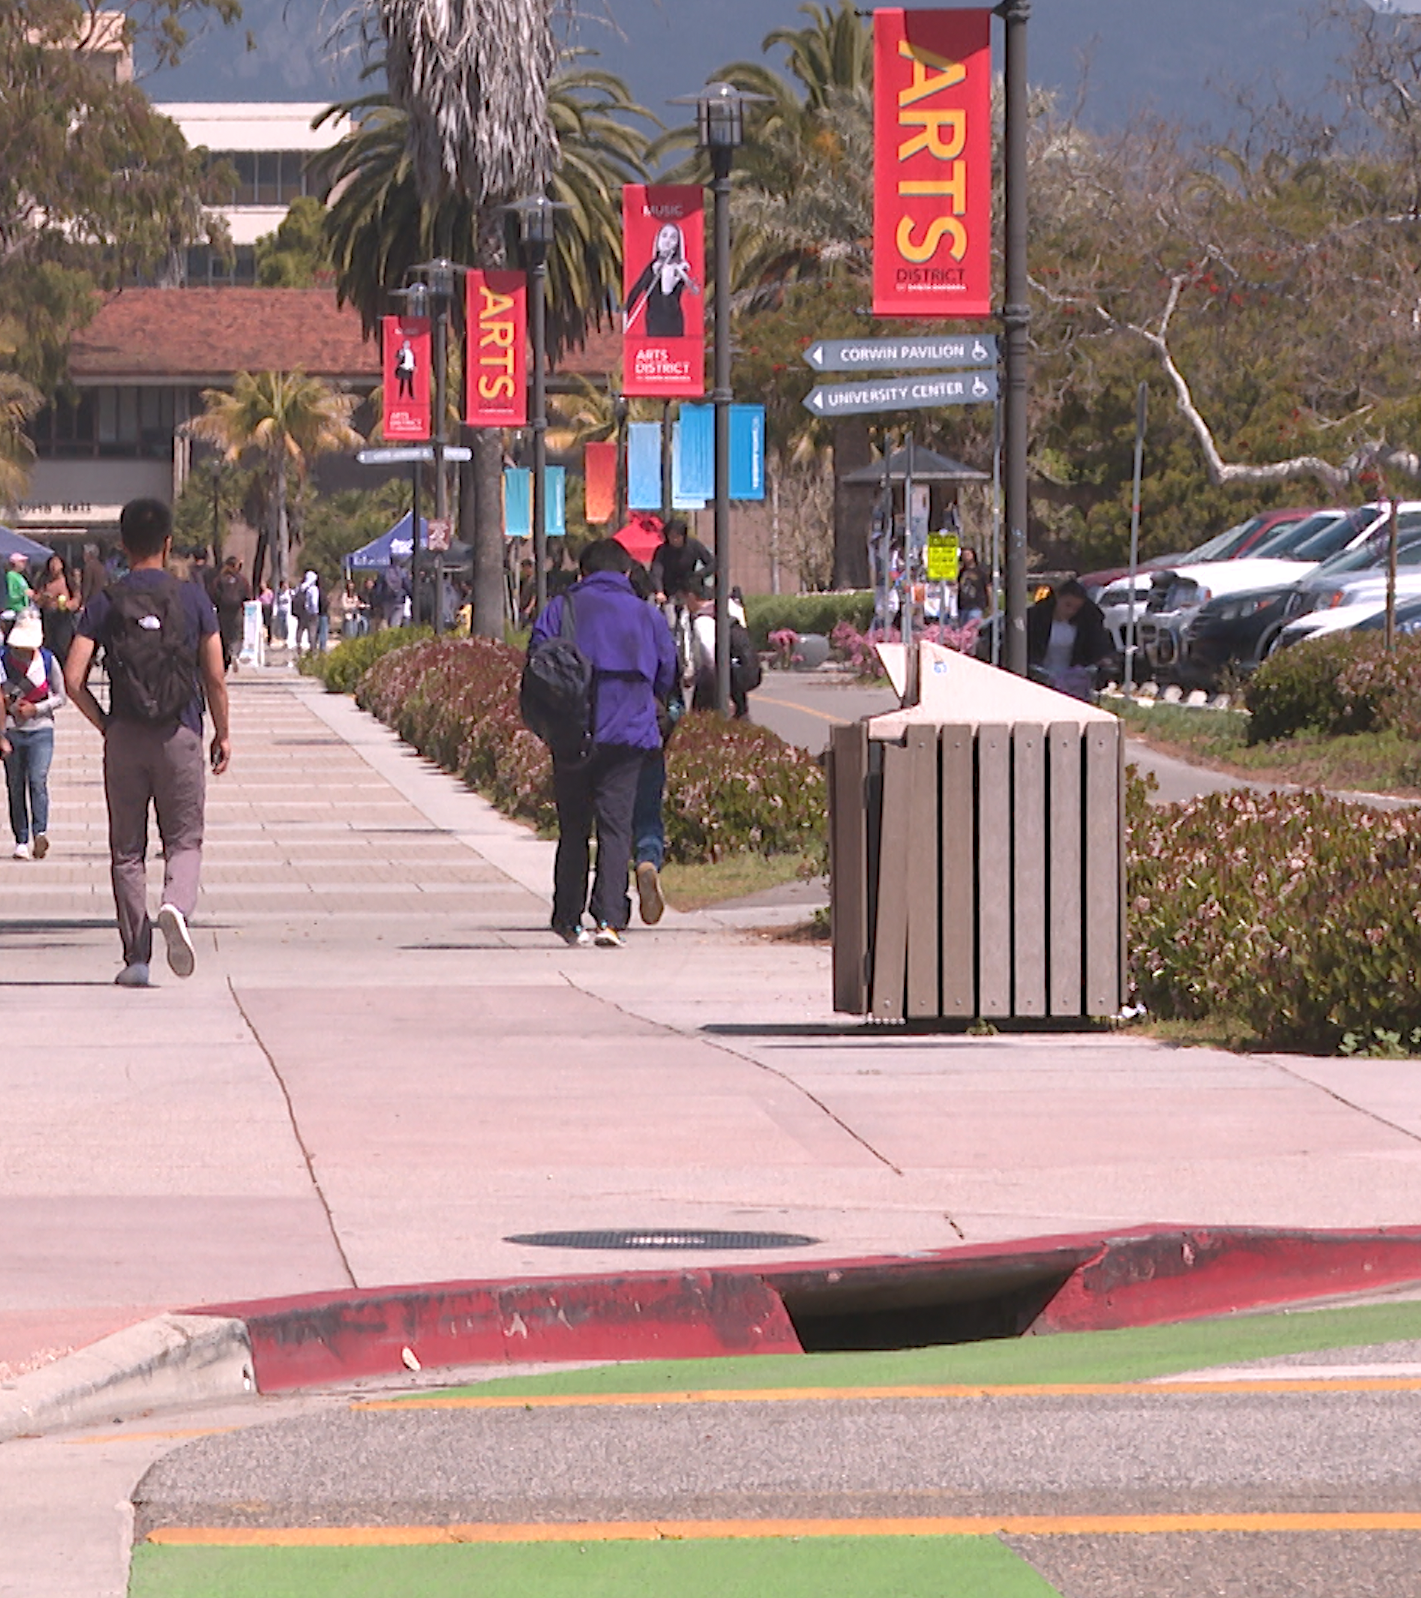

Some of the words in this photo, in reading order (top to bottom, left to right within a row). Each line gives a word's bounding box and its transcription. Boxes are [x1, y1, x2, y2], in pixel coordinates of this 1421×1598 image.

[896, 40, 969, 264] ARTS
[896, 268, 965, 283] DISTRICT
[479, 285, 515, 401] ARTS
[636, 349, 668, 361] ARTS
[840, 346, 897, 362] CORWIN
[901, 344, 965, 360] PAVILION
[635, 362, 690, 374] DISTRICT
[828, 386, 908, 407] UNIVERSITY
[912, 381, 964, 398] CENTER
